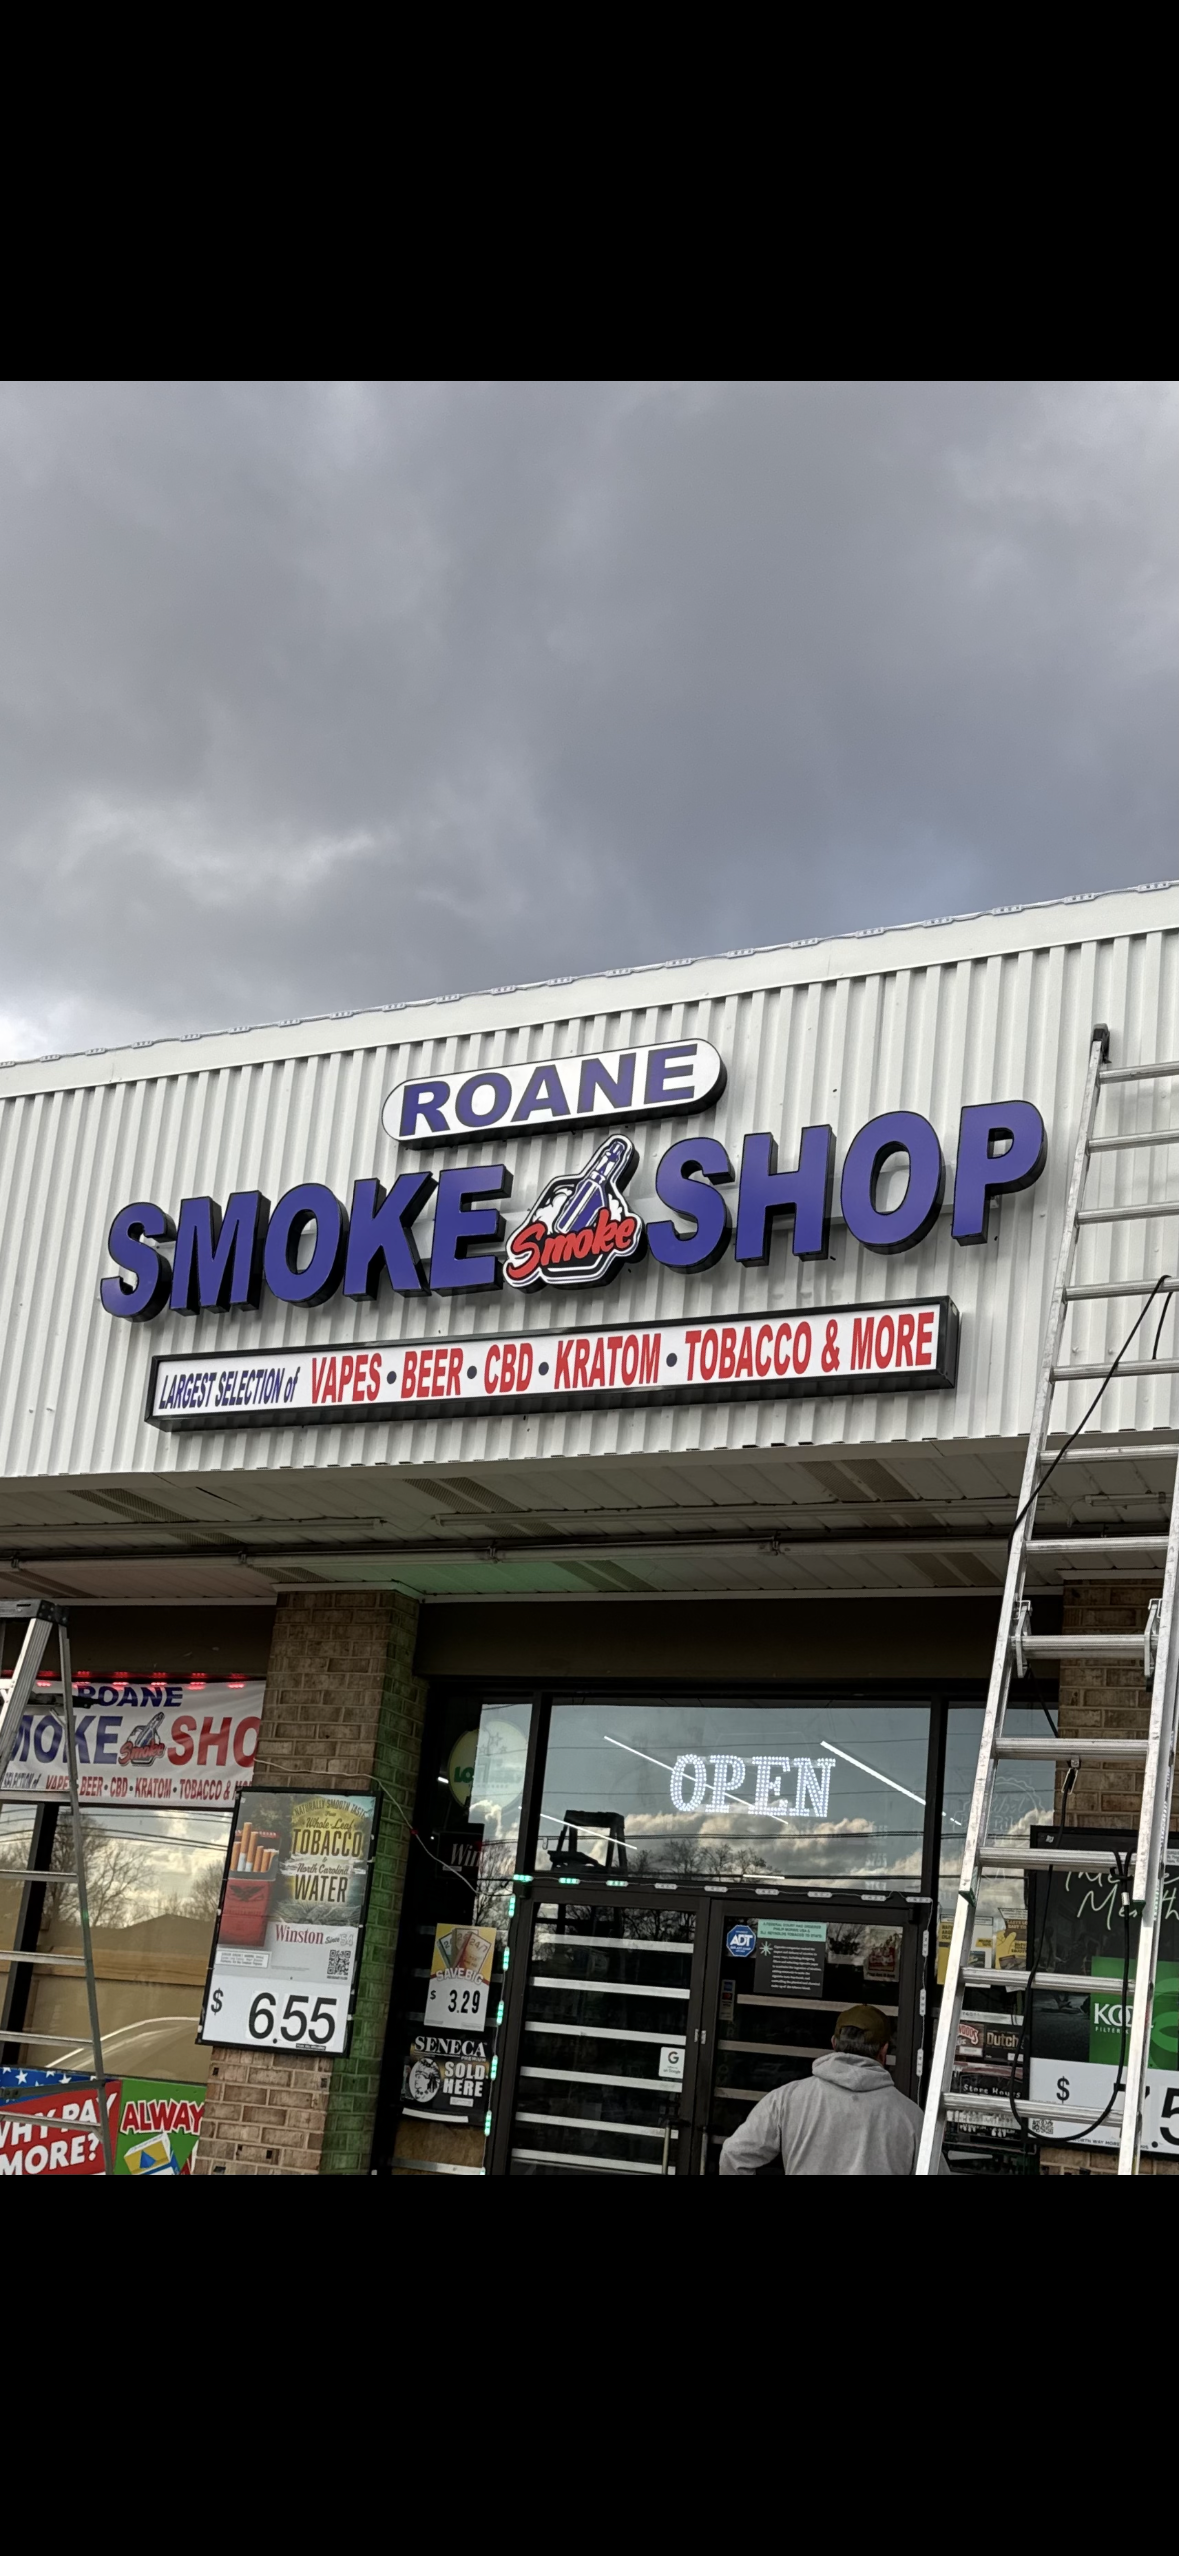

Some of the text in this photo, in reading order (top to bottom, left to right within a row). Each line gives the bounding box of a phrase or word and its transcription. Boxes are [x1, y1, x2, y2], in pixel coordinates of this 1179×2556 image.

[398, 1043, 699, 1138] ROANE
[100, 1100, 1044, 1319] SMOKE SHOP
[507, 1208, 637, 1280] Smoke
[158, 1311, 935, 1410] LARGEST SELECTION of VAPES BEER CBD KRATOM TOBACCO & MORE
[77, 1685, 183, 1708] ROANE
[10, 1714, 261, 1768] MOKE SHO
[118, 1737, 166, 1766] Smoke
[46, 1774, 70, 1790] VAPE
[79, 1776, 104, 1797] BEER
[110, 1776, 128, 1798] CBD
[134, 1777, 173, 1799] KRATOM
[180, 1779, 223, 1801] TOBACCO
[223, 1780, 232, 1801] &
[669, 1753, 837, 1818] OPEN
[326, 1798, 351, 1812] SMOOTH
[291, 1828, 364, 1858] TOBACCO
[296, 1862, 350, 1876] North Carolina
[293, 1873, 349, 1903] WATER
[274, 1923, 325, 1945] Winston
[469, 1939, 489, 1953] 24/7
[729, 1933, 753, 1947] ADT
[436, 1967, 484, 1986] SAVE BIG
[429, 1988, 481, 2014] $ 3.29
[210, 1987, 338, 2045] $ 6.55
[414, 2035, 486, 2058] SENECA
[444, 2061, 486, 2080] SOLD
[442, 2078, 484, 2098] HERE
[963, 2083, 989, 2096] Store
[1056, 2075, 1070, 2104] $
[119, 2098, 206, 2136] ALWAY
[0, 2131, 101, 2175] MORE?
